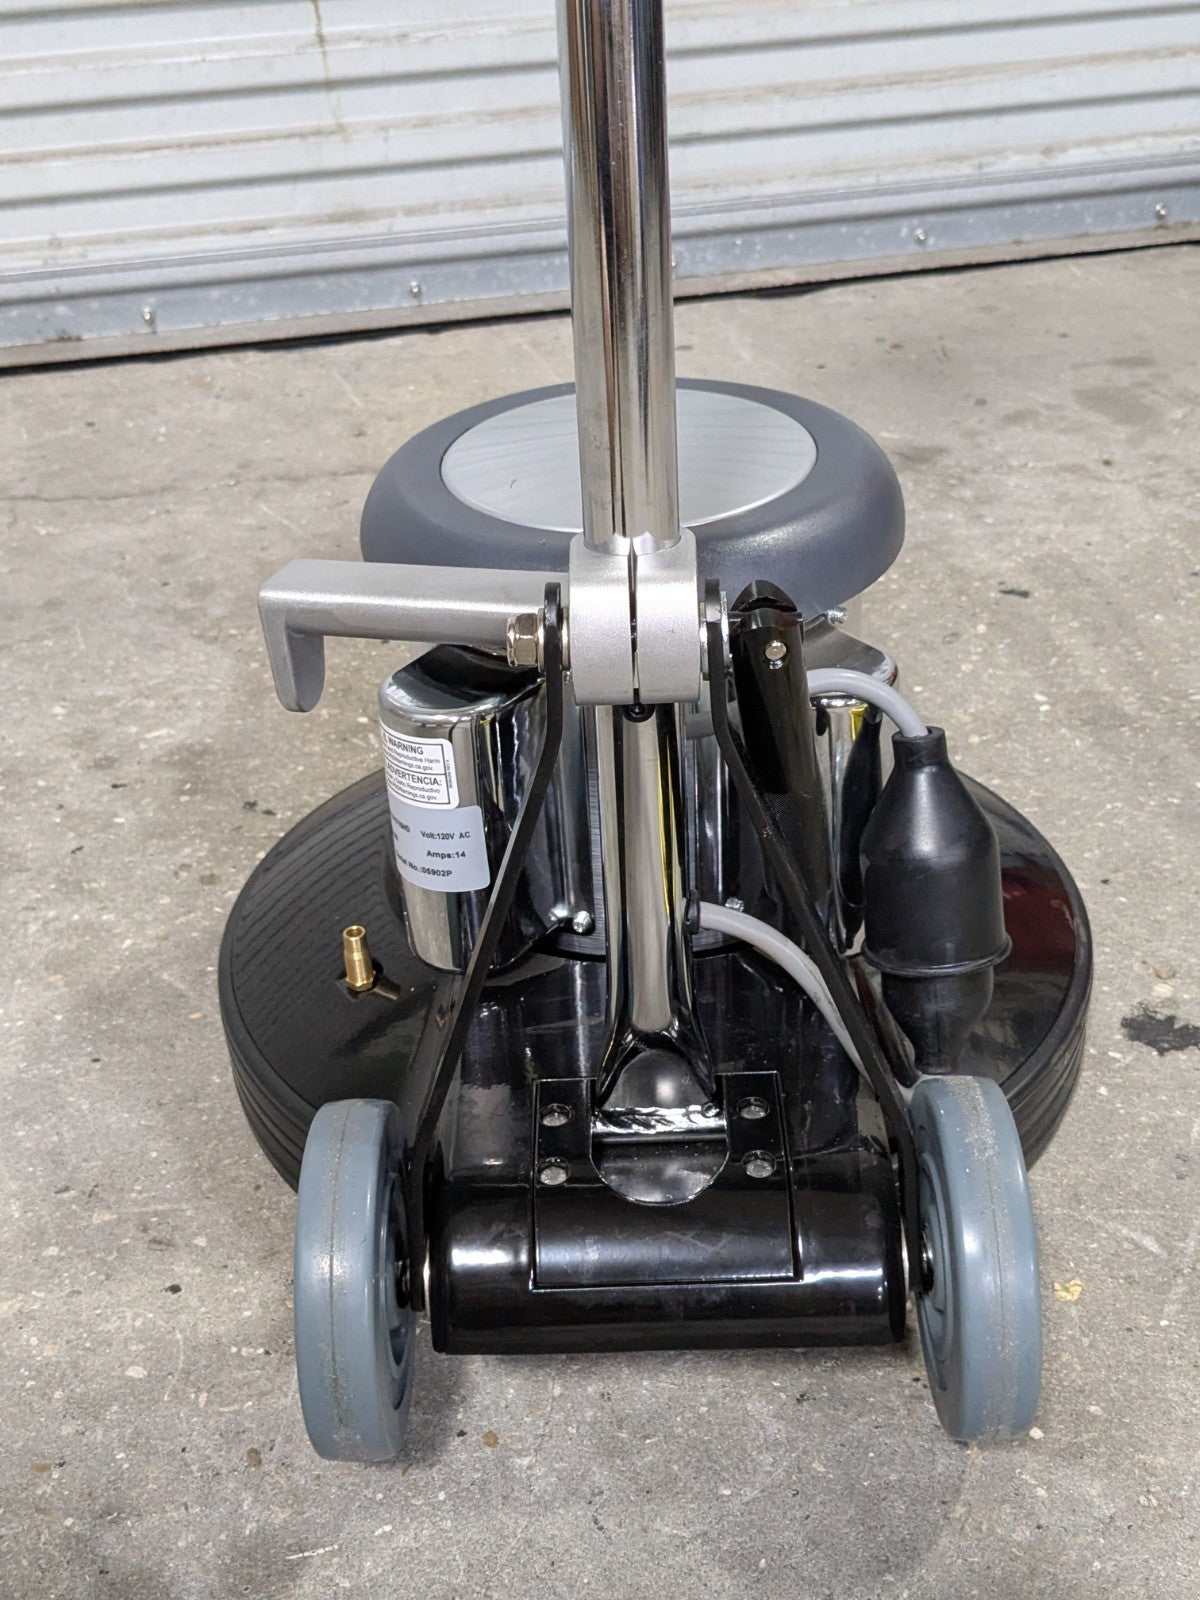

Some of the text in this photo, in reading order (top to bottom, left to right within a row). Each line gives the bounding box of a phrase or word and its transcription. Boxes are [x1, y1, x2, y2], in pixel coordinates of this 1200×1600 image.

[388, 736, 424, 755] WARNING
[387, 762, 442, 786] ADVERTENCIA:
[420, 830, 471, 840] Volt:120V AC
[426, 850, 466, 860] Amps:14
